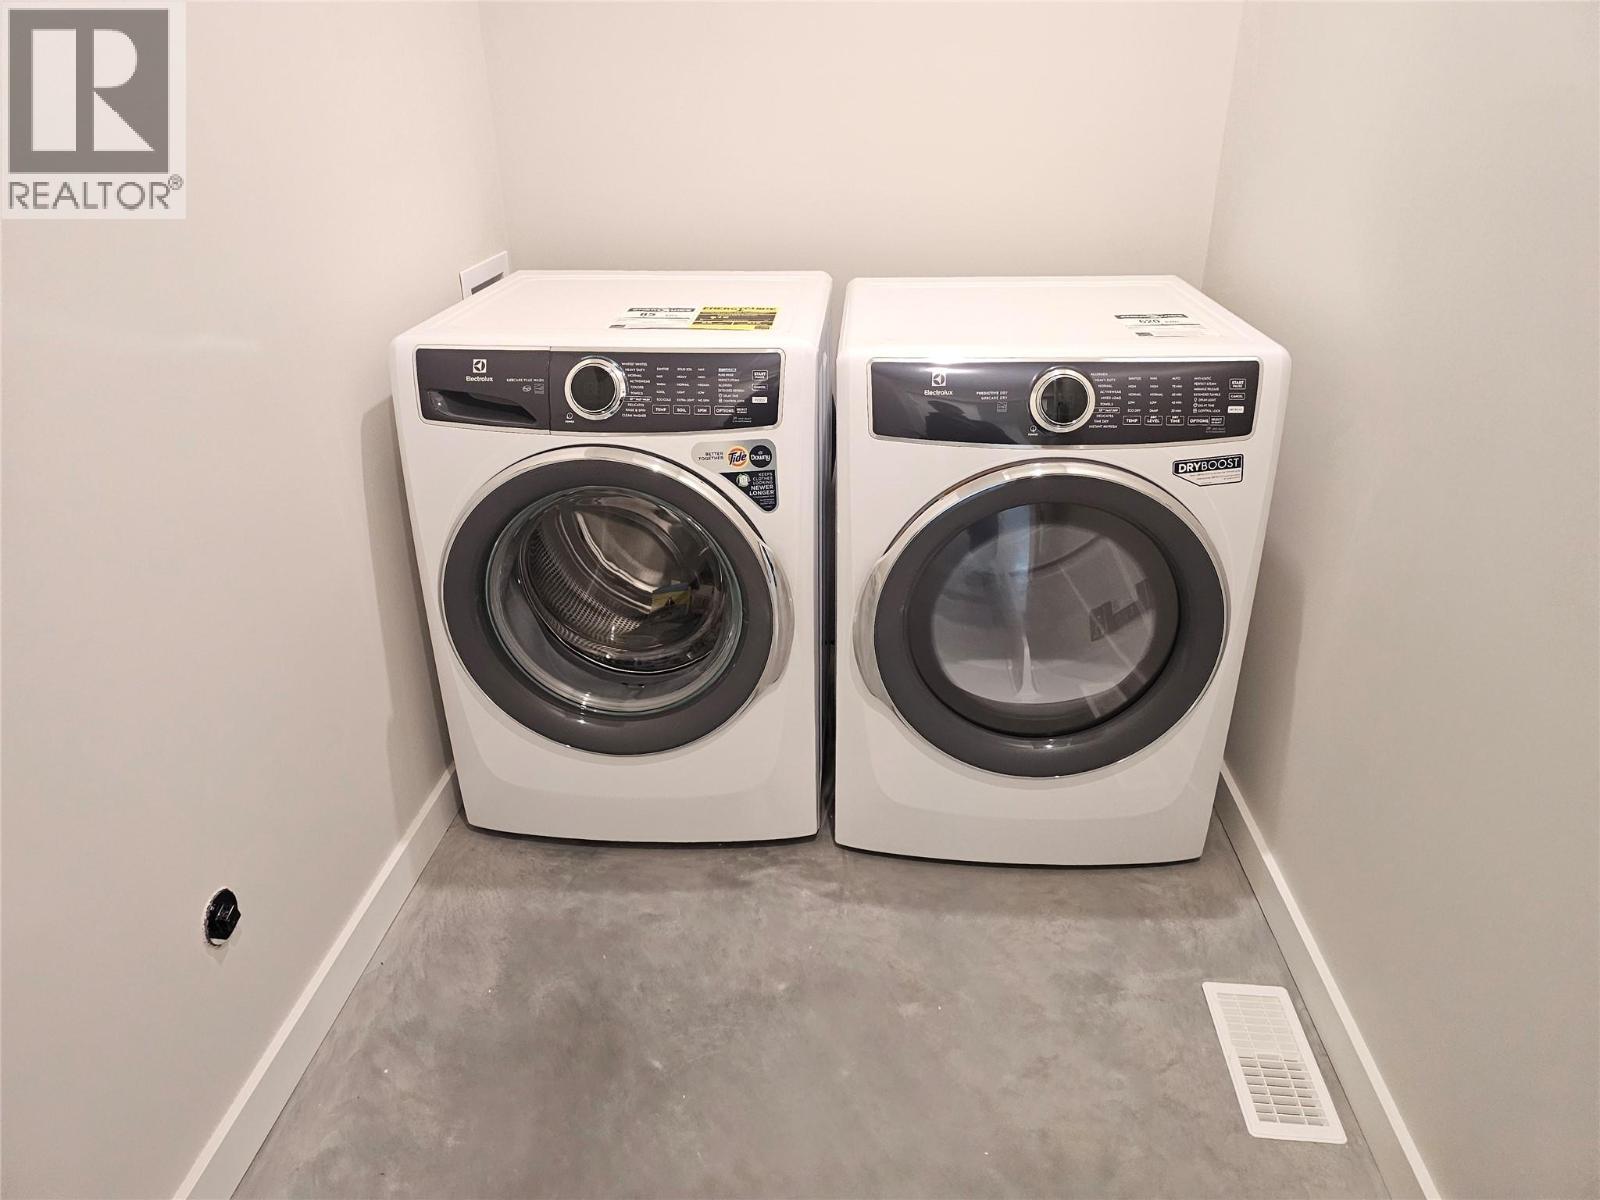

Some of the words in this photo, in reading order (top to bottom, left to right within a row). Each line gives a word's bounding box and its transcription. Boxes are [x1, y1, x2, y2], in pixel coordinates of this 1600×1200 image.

[728, 451, 747, 465] Tide
[751, 454, 771, 462] Downy
[1178, 458, 1239, 473] DRYBOOST
